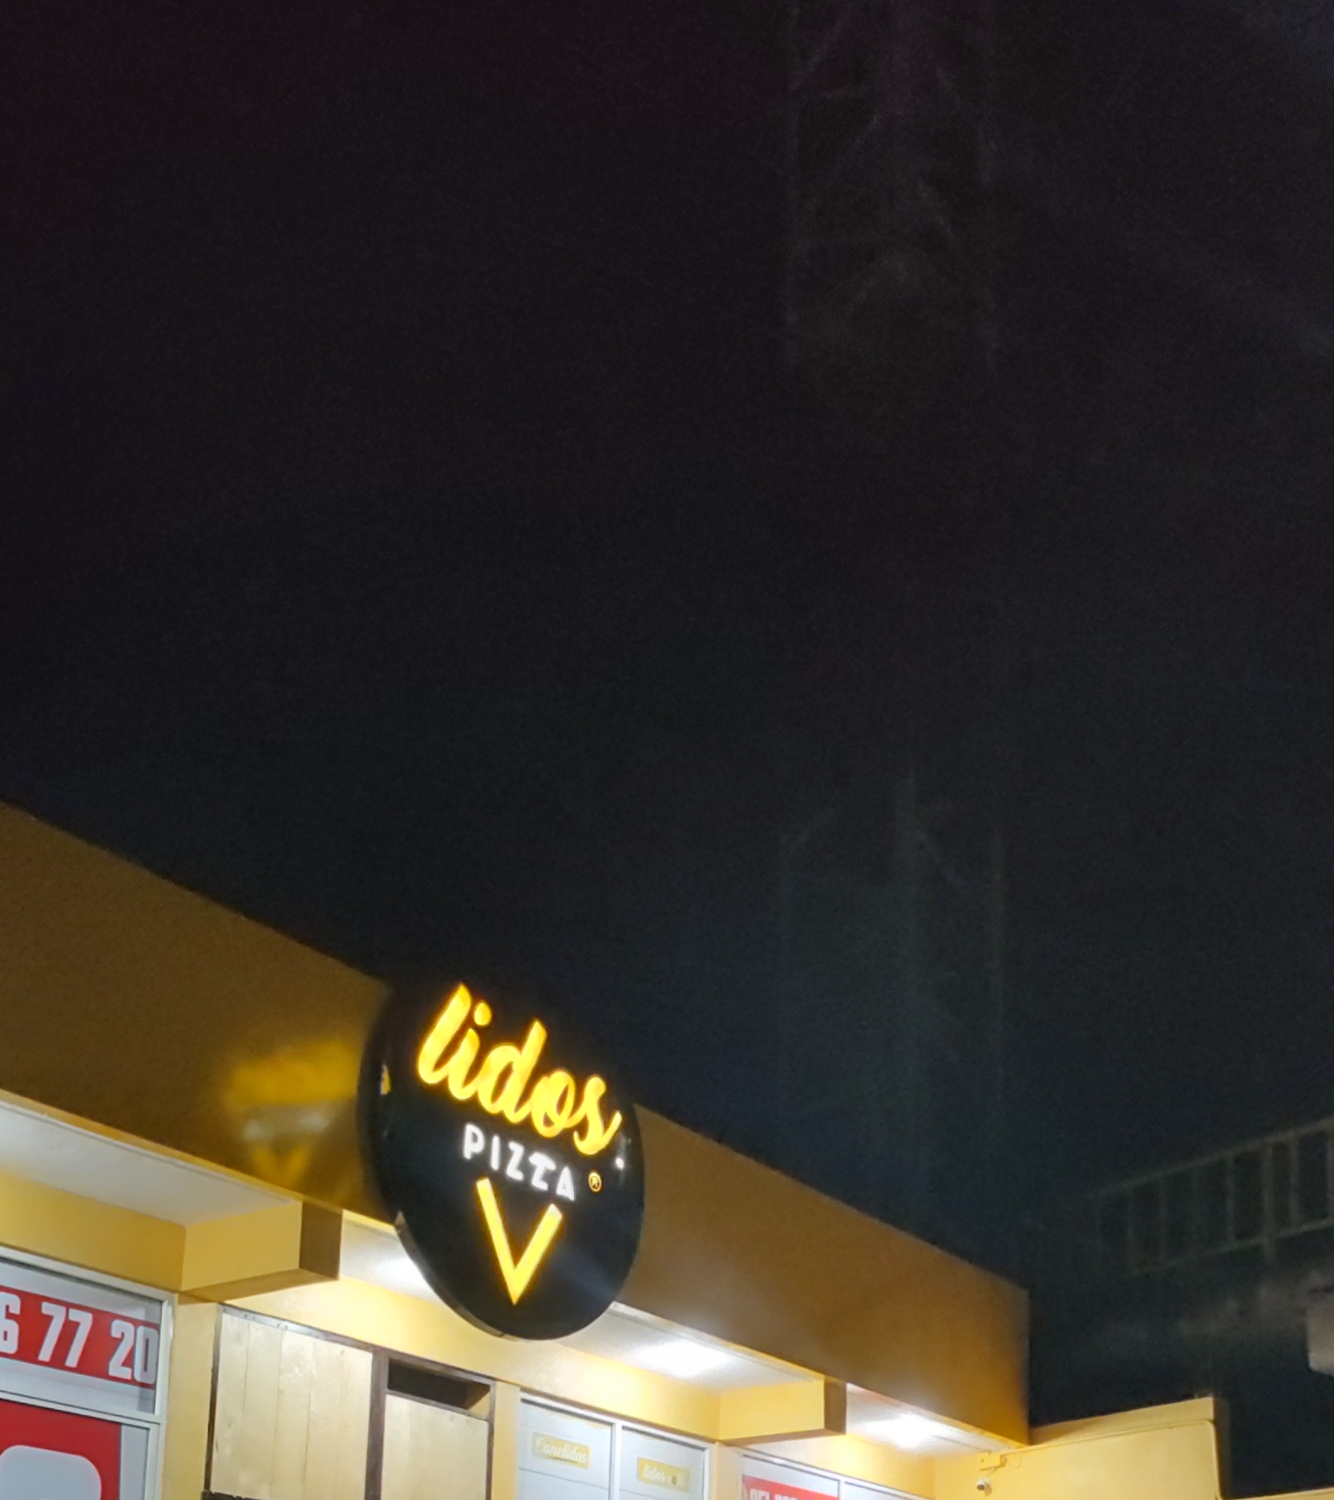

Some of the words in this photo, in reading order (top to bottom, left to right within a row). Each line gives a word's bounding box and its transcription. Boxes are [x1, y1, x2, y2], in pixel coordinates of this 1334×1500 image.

[416, 981, 623, 1156] lidos
[462, 1123, 576, 1201] PIZZA
[37, 1302, 94, 1369] 77
[109, 1321, 159, 1385] 20
